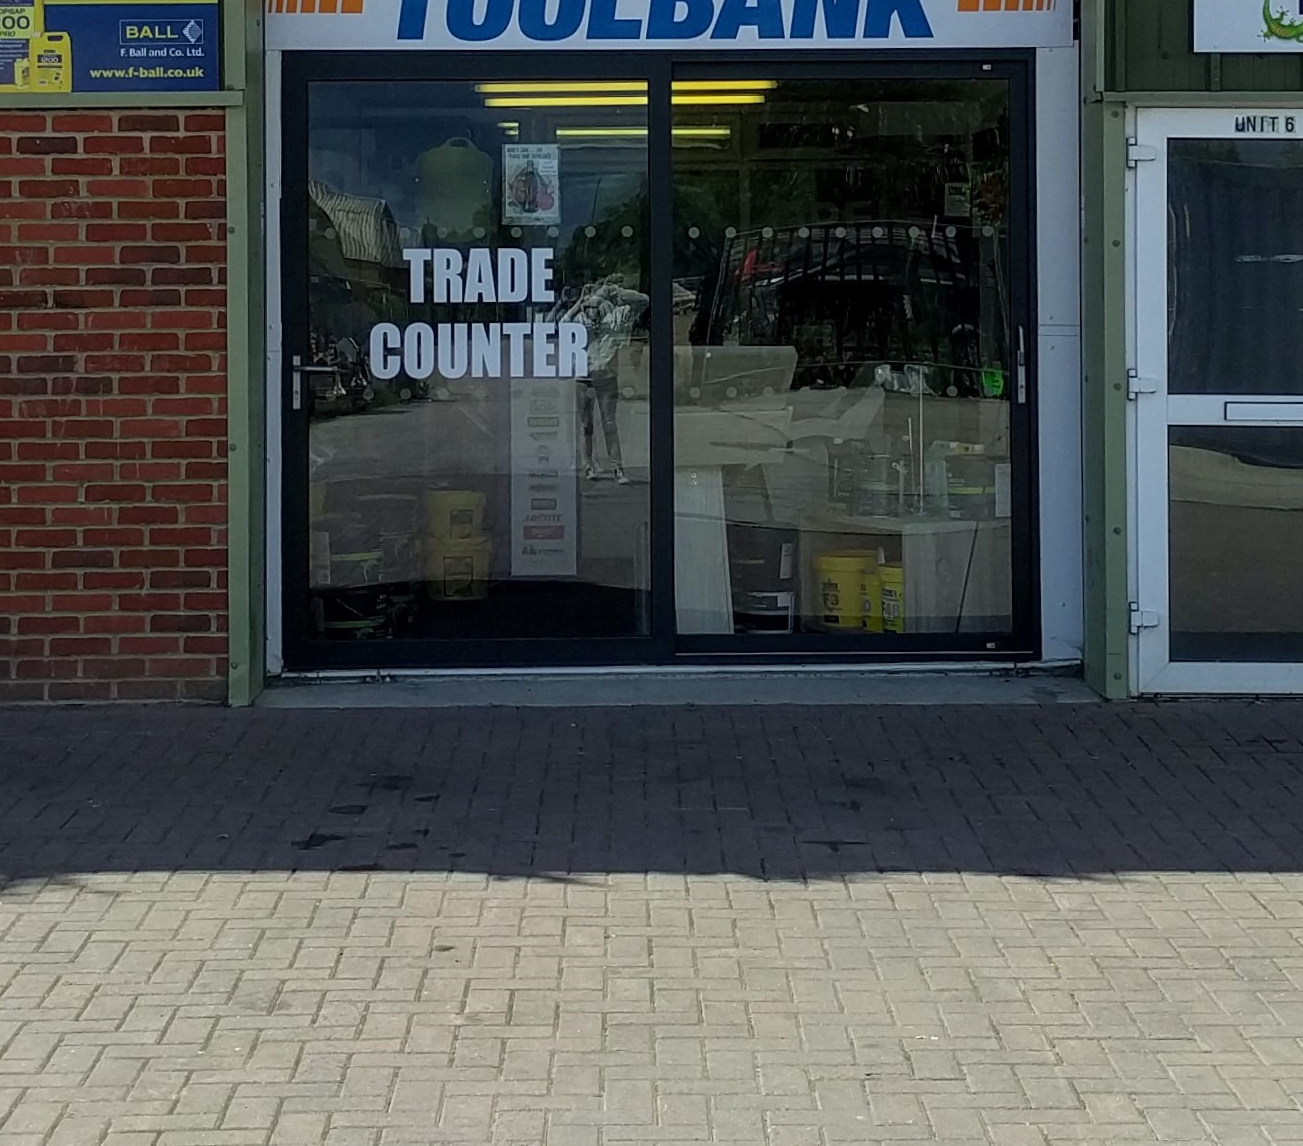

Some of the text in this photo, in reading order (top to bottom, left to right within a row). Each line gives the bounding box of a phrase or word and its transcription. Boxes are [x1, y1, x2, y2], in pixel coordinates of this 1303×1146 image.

[126, 26, 178, 38] BALL
[120, 47, 204, 57] F. Ball and Co. Ltd.
[90, 67, 204, 78] www.f-ball.co.uk
[1235, 116, 1295, 132] UNIT 6
[402, 247, 555, 303] TRADE
[369, 322, 588, 379] COUNTER
